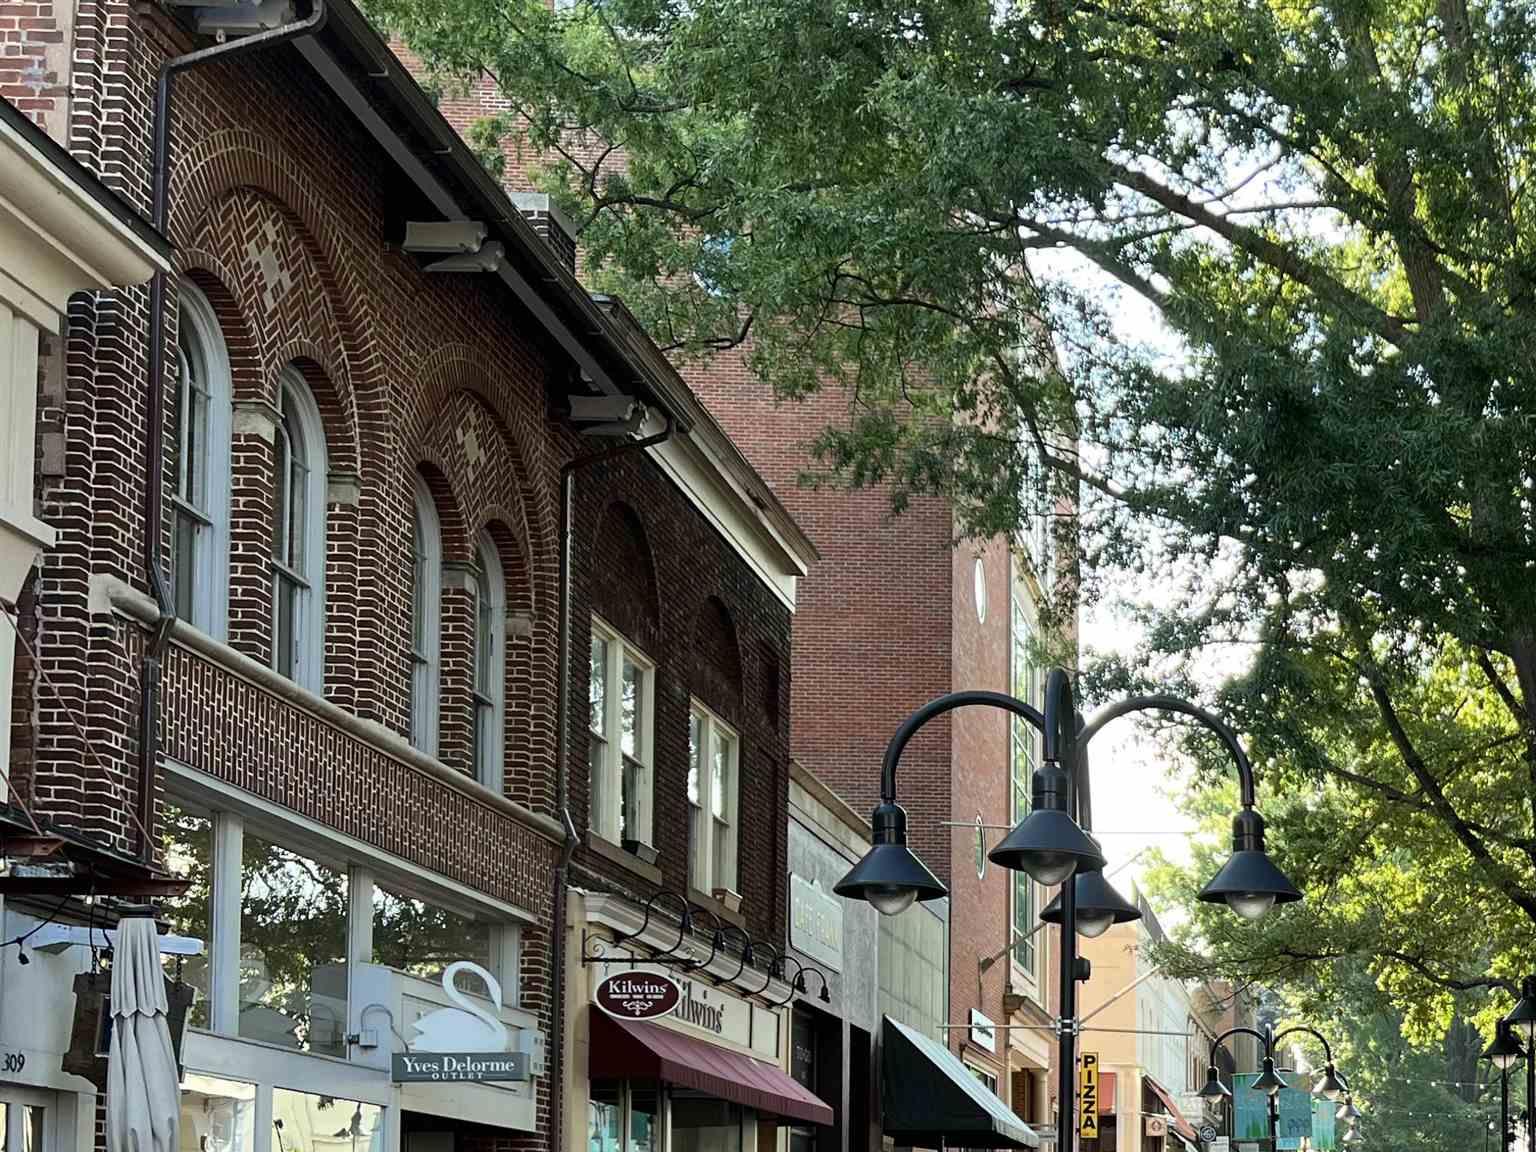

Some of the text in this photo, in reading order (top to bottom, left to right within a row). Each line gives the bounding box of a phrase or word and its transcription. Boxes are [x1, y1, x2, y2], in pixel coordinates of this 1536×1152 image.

[1, 1053, 25, 1072] 309
[403, 1056, 515, 1073] Yves Delorme
[431, 1072, 484, 1080] OUTLET
[1083, 1055, 1096, 1129] PIZZA
